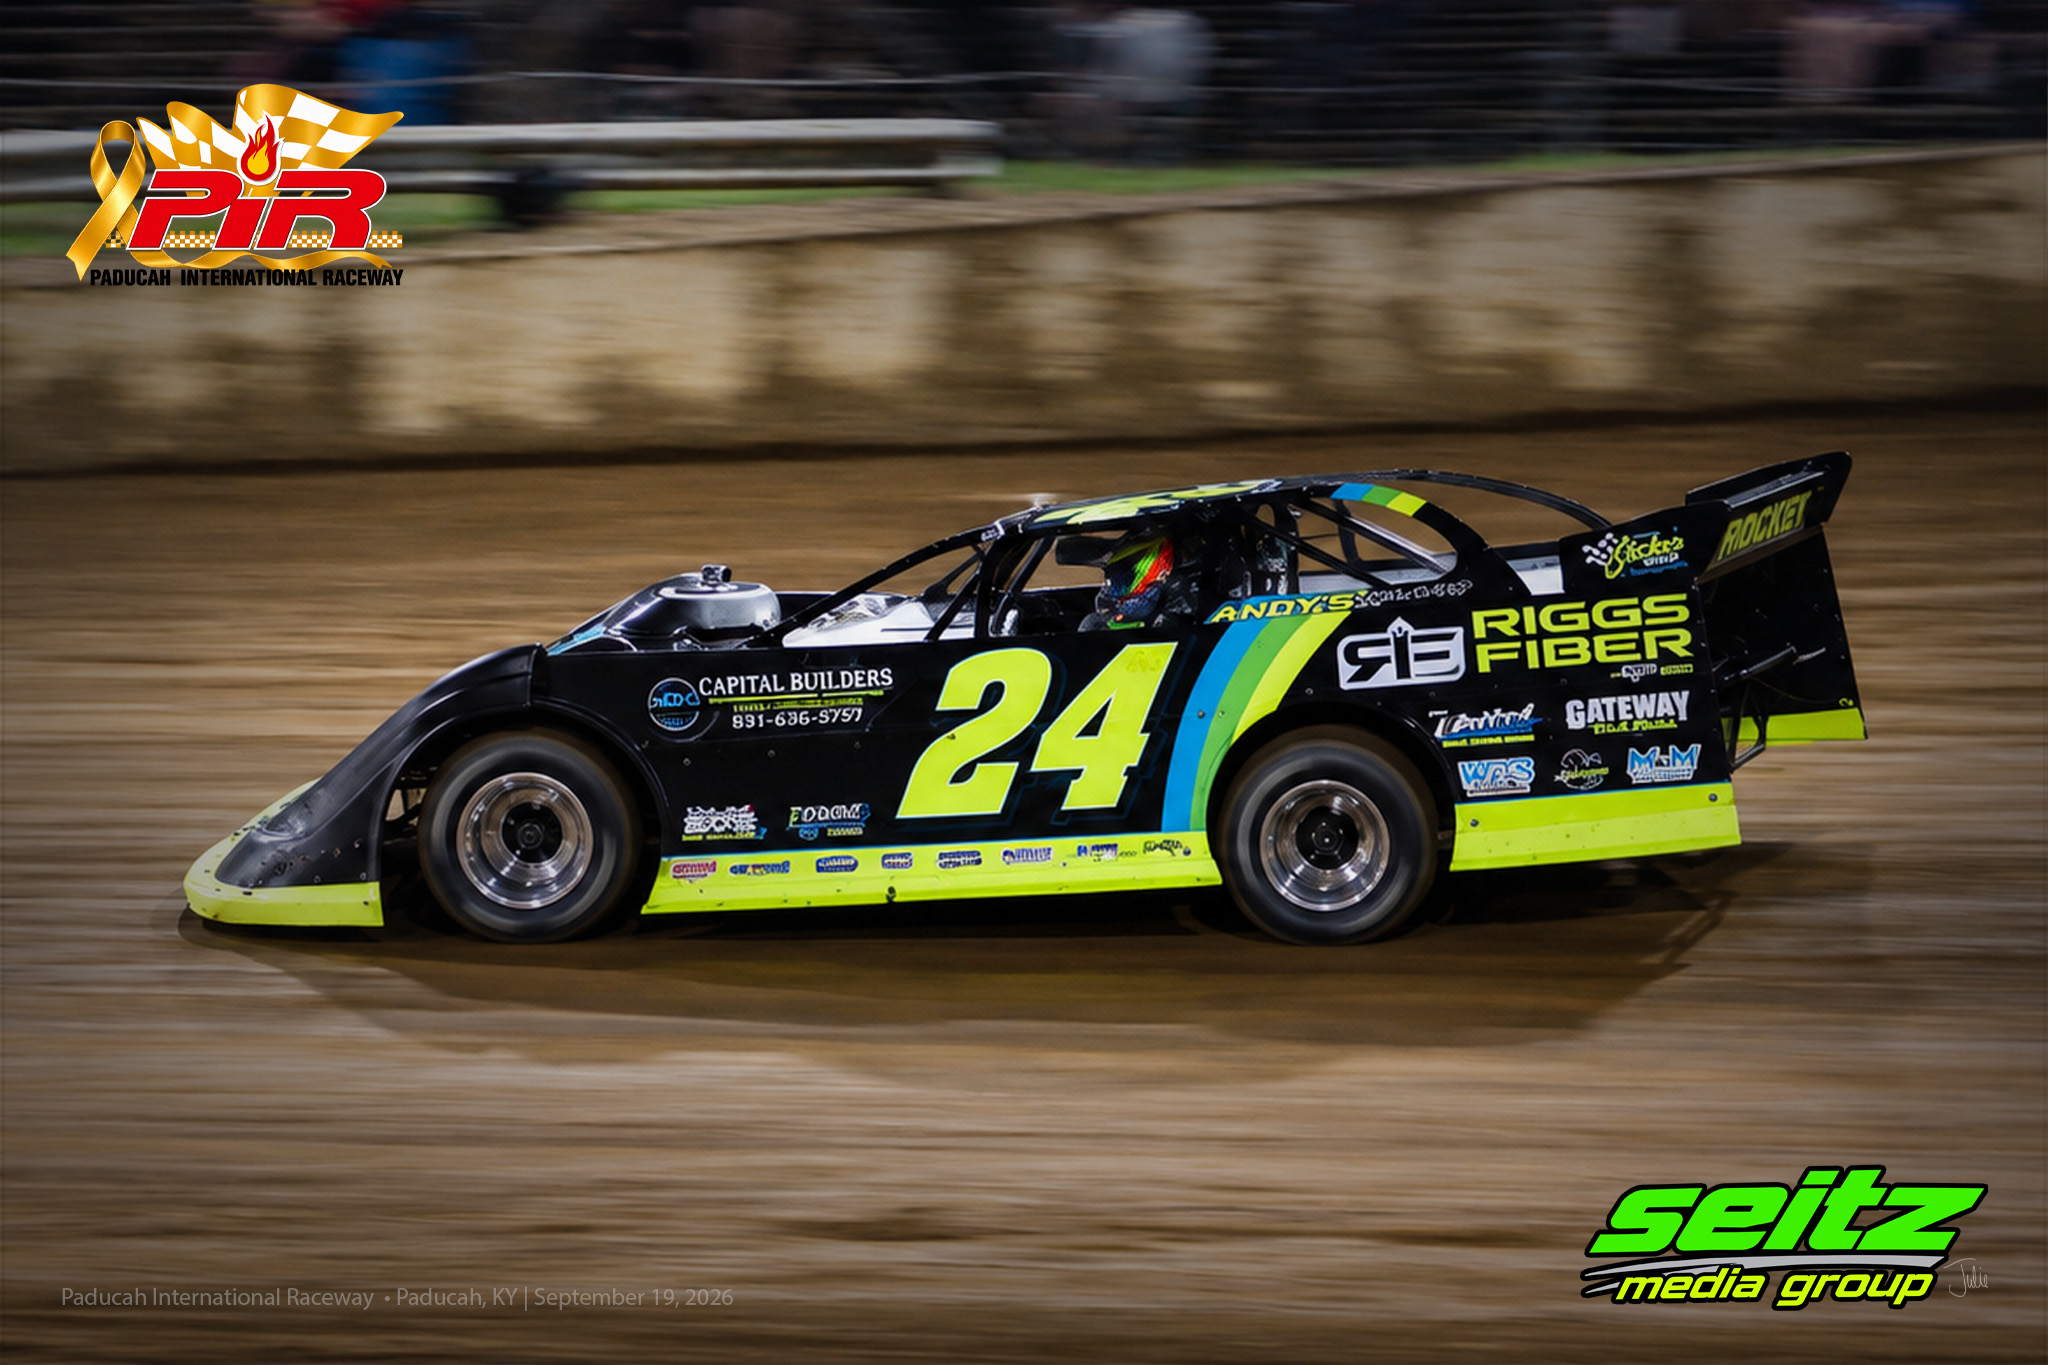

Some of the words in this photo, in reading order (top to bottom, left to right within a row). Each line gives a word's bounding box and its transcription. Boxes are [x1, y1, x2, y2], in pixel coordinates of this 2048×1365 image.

[1717, 492, 1811, 561] ROCKET
[1211, 590, 1369, 623] ANDY'S
[1472, 594, 1690, 639] RIGGS
[1475, 628, 1694, 673] FIBER
[699, 675, 785, 697] CAPITAL
[790, 668, 893, 691] BUILDERS
[896, 641, 1178, 818] 24
[1565, 690, 1690, 730] GATEWAY
